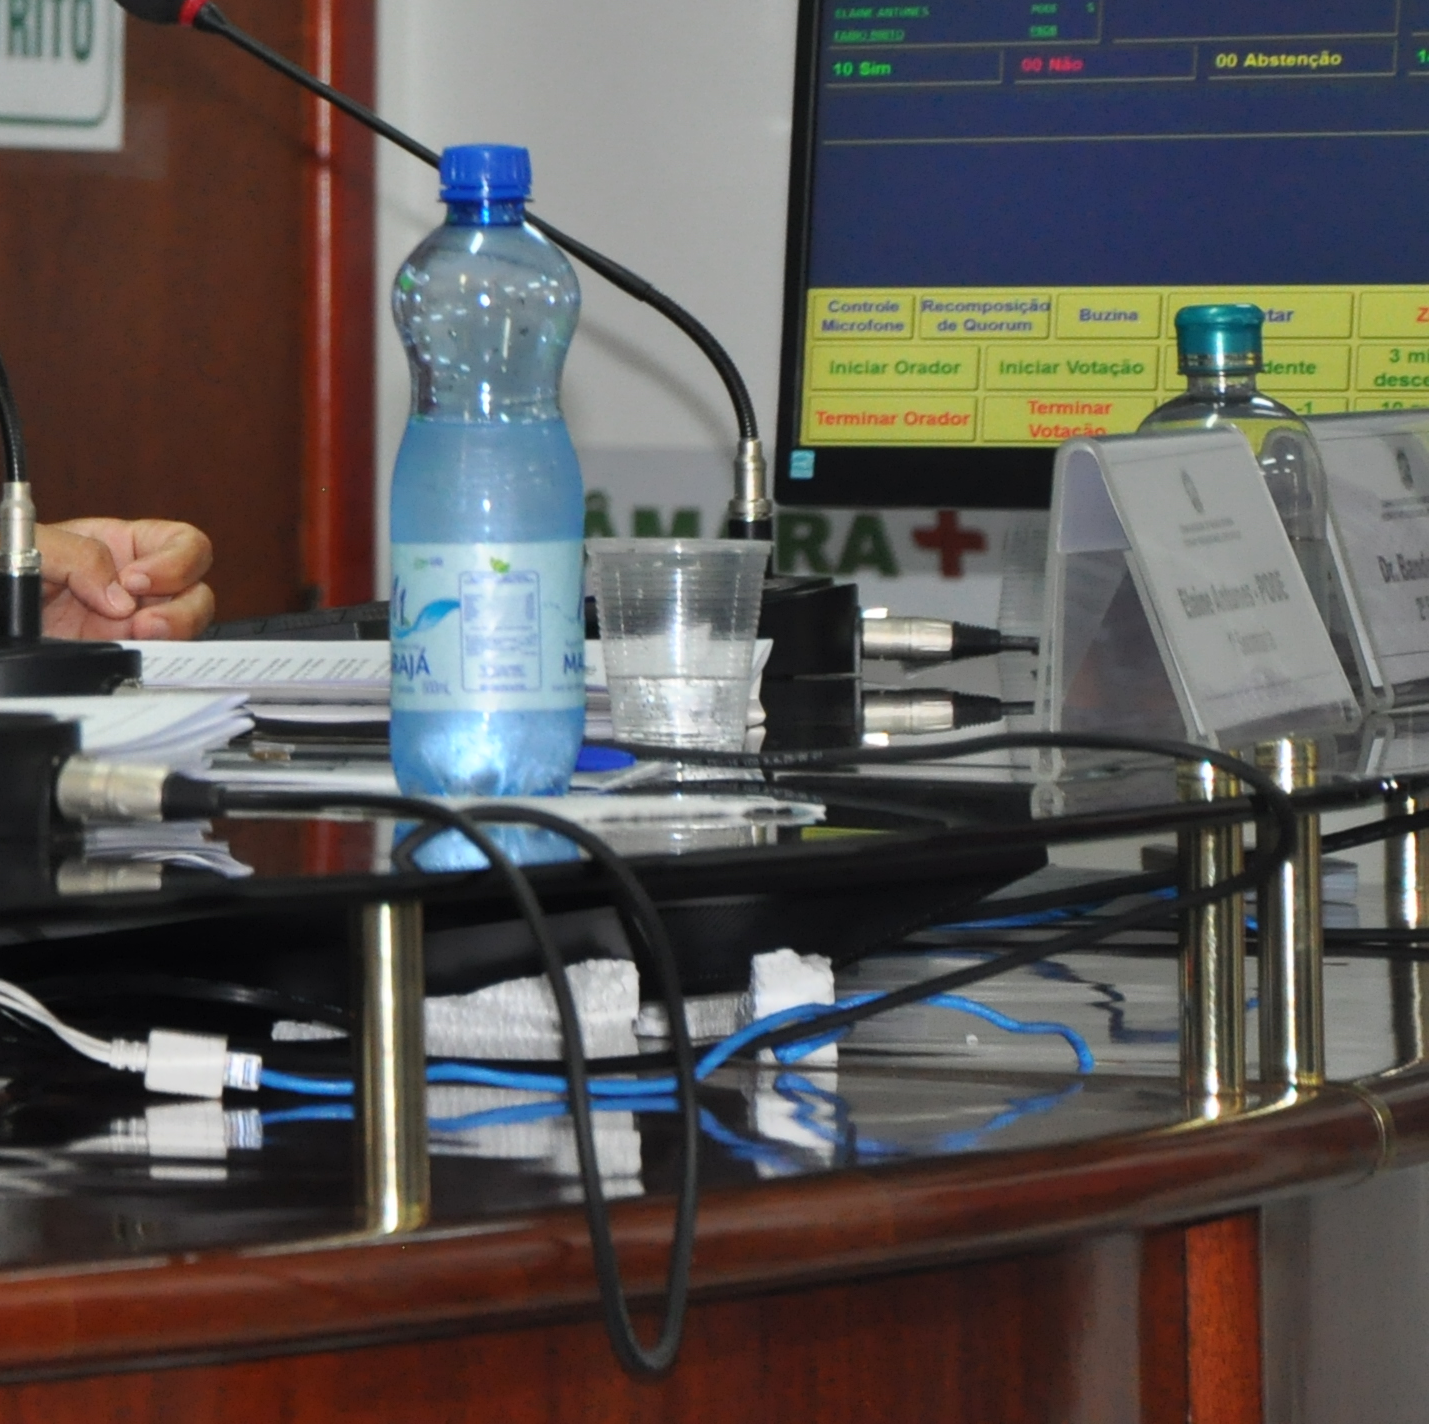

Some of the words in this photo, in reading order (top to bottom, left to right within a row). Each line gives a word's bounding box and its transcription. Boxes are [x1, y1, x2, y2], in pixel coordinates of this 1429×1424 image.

[1021, 58, 1043, 72] 00
[1049, 56, 1084, 71] Não
[1215, 53, 1238, 67] 00
[1243, 50, 1342, 69] Abstenção
[833, 63, 853, 76] 10
[859, 61, 892, 75] Sim
[828, 299, 900, 313] Controle
[921, 298, 1052, 315] Recomposição
[1079, 308, 1139, 322] Buzina
[821, 319, 904, 332] Microfone
[937, 319, 957, 332] de
[963, 318, 1033, 332] Quorum
[1389, 349, 1400, 363] 3
[829, 360, 888, 375] Iniciar
[894, 360, 961, 375] Orador
[999, 360, 1059, 375] Iniciar
[1066, 359, 1144, 376] Votação
[1028, 400, 1112, 415] Terminar
[816, 411, 898, 426] Terminar
[904, 411, 971, 426] Orador
